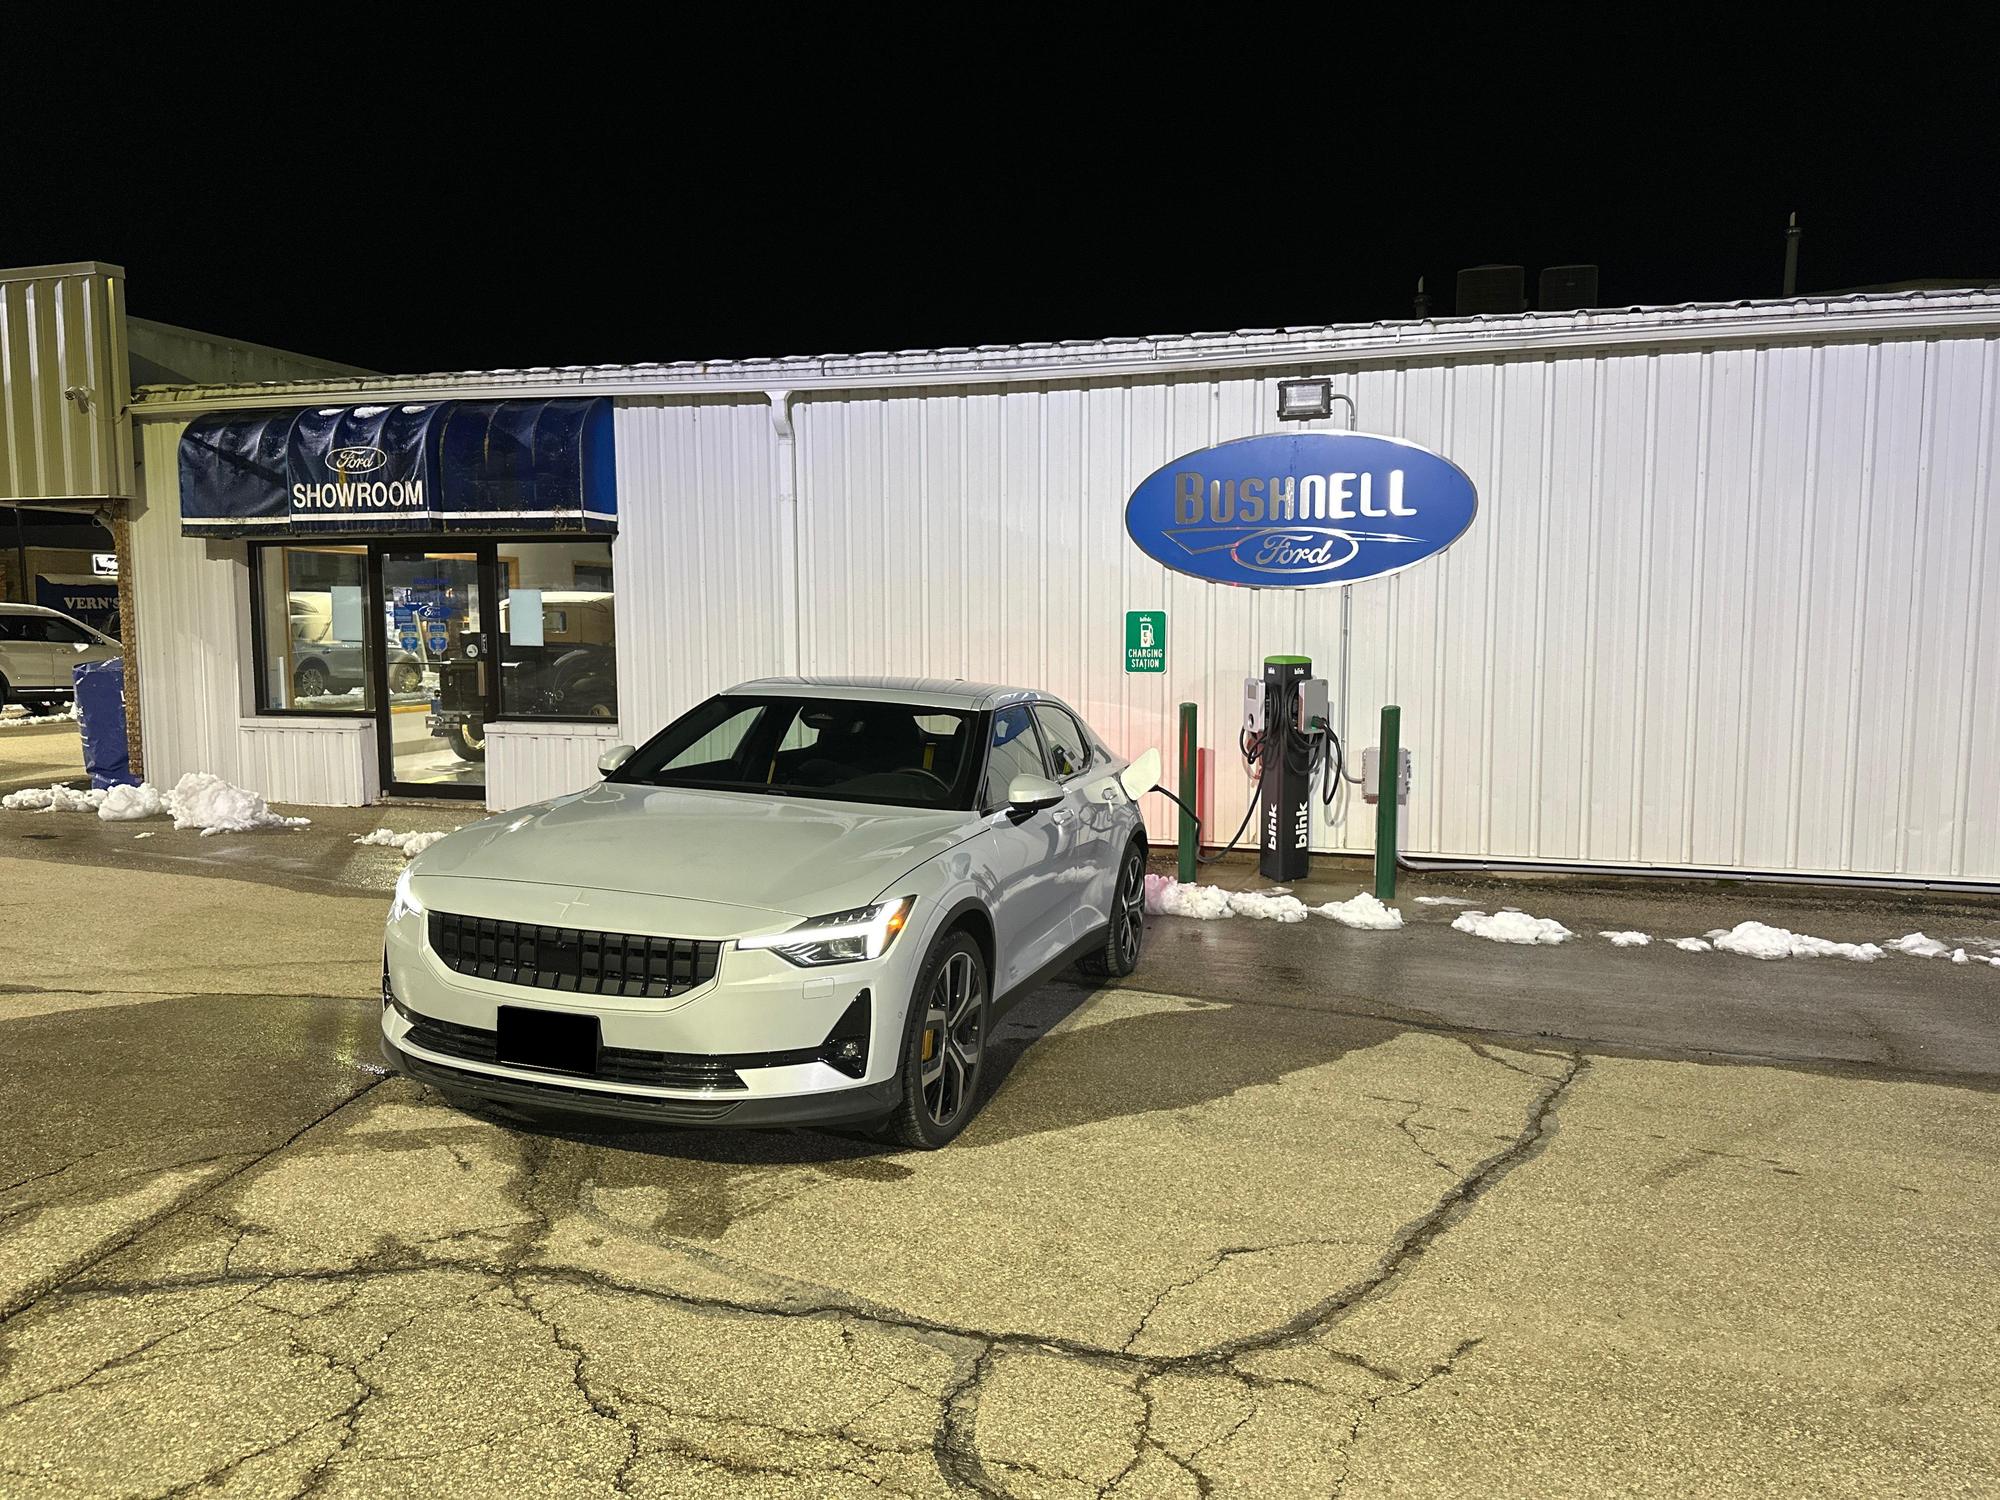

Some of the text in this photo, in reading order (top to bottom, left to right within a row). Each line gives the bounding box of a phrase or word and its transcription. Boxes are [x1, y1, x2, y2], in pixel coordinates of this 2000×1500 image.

[336, 450, 374, 469] Ford
[293, 480, 423, 508] SHOWROOM
[1255, 535, 1333, 565] Ford
[1128, 648, 1163, 658] CHARGING
[1131, 658, 1160, 669] STATION
[1267, 803, 1278, 851] blink
[1295, 801, 1308, 849] blink
